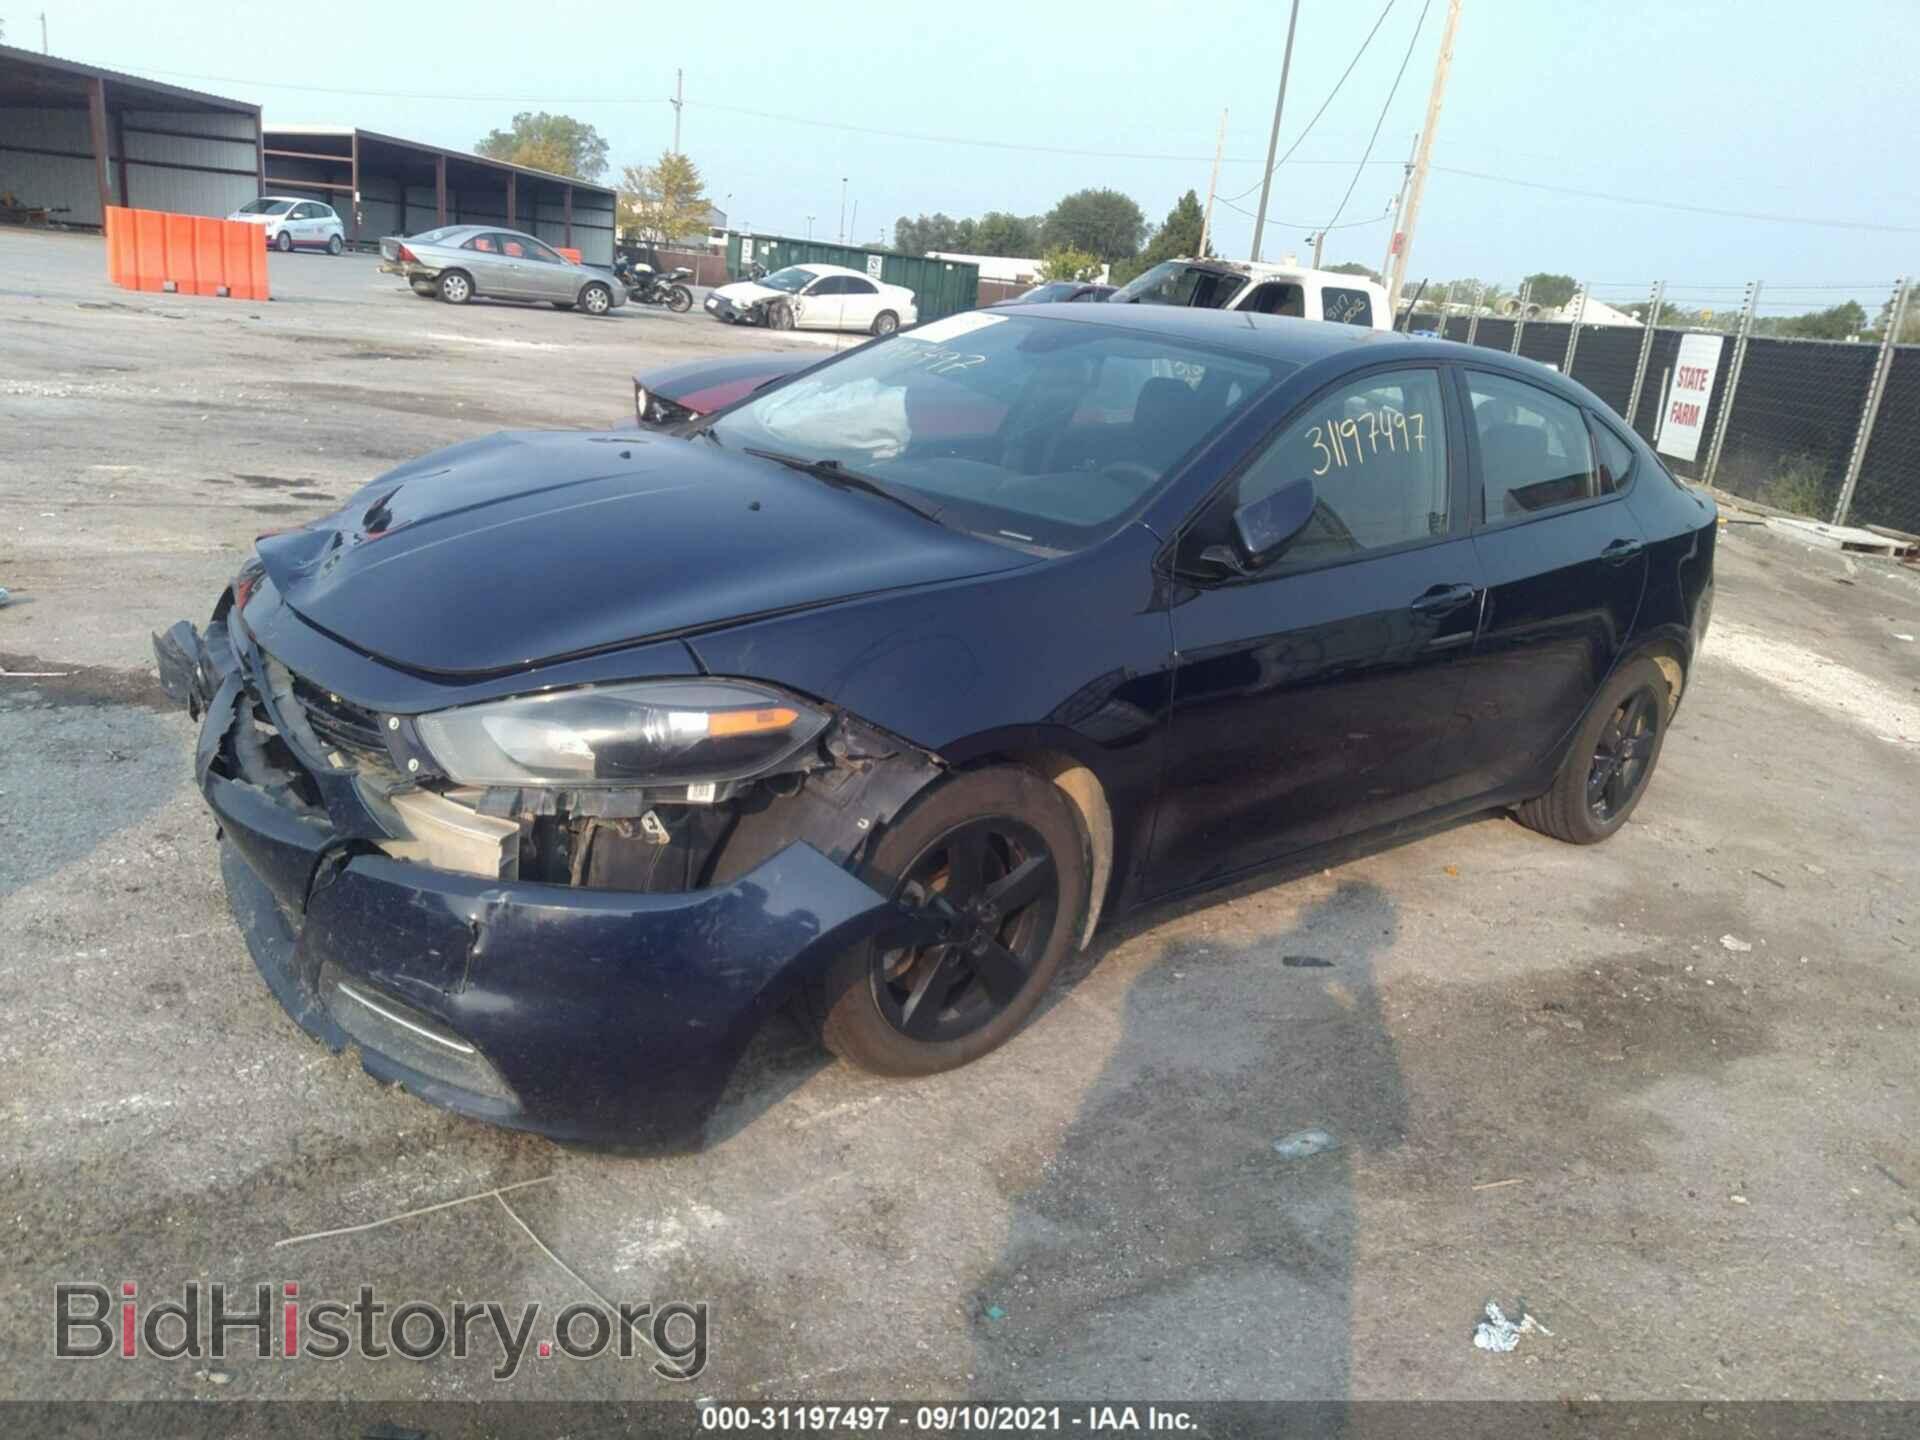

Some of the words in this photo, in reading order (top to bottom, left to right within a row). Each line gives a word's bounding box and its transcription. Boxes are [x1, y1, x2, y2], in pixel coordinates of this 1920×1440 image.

[1677, 366, 1709, 391] STATE
[1670, 401, 1701, 427] FARM
[1304, 408, 1426, 475] 31197497
